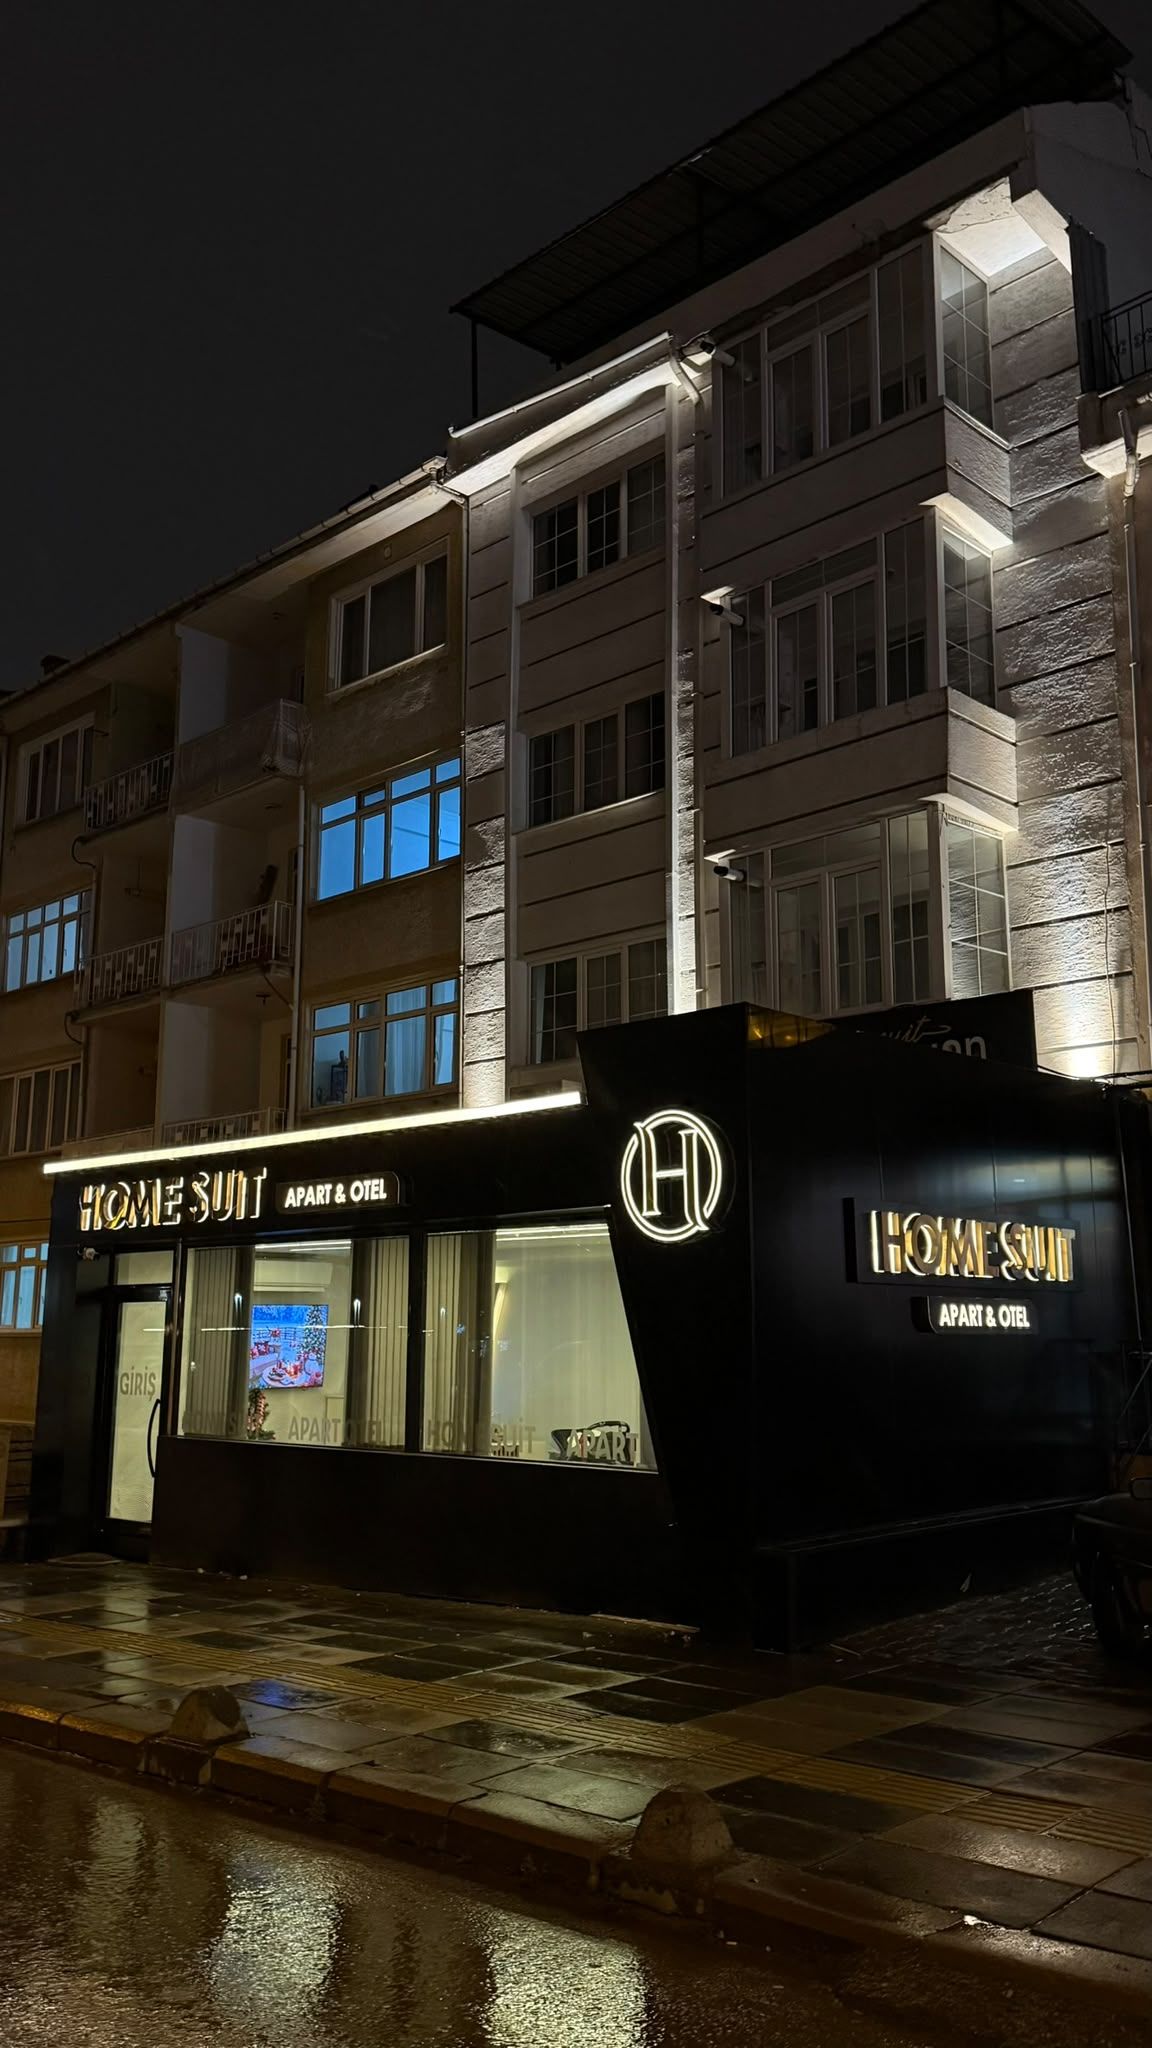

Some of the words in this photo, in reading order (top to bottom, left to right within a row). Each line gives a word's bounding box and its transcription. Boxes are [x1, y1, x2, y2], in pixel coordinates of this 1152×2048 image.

[285, 1183, 333, 1208] APART
[334, 1183, 346, 1202] &
[350, 1177, 387, 1201] OTEL
[939, 1303, 983, 1327] APART
[986, 1307, 997, 1327] &
[999, 1305, 1030, 1328] OTEL
[120, 1365, 156, 1401] GİRİŞ
[288, 1415, 342, 1445] APART
[566, 1428, 639, 1463] APART
